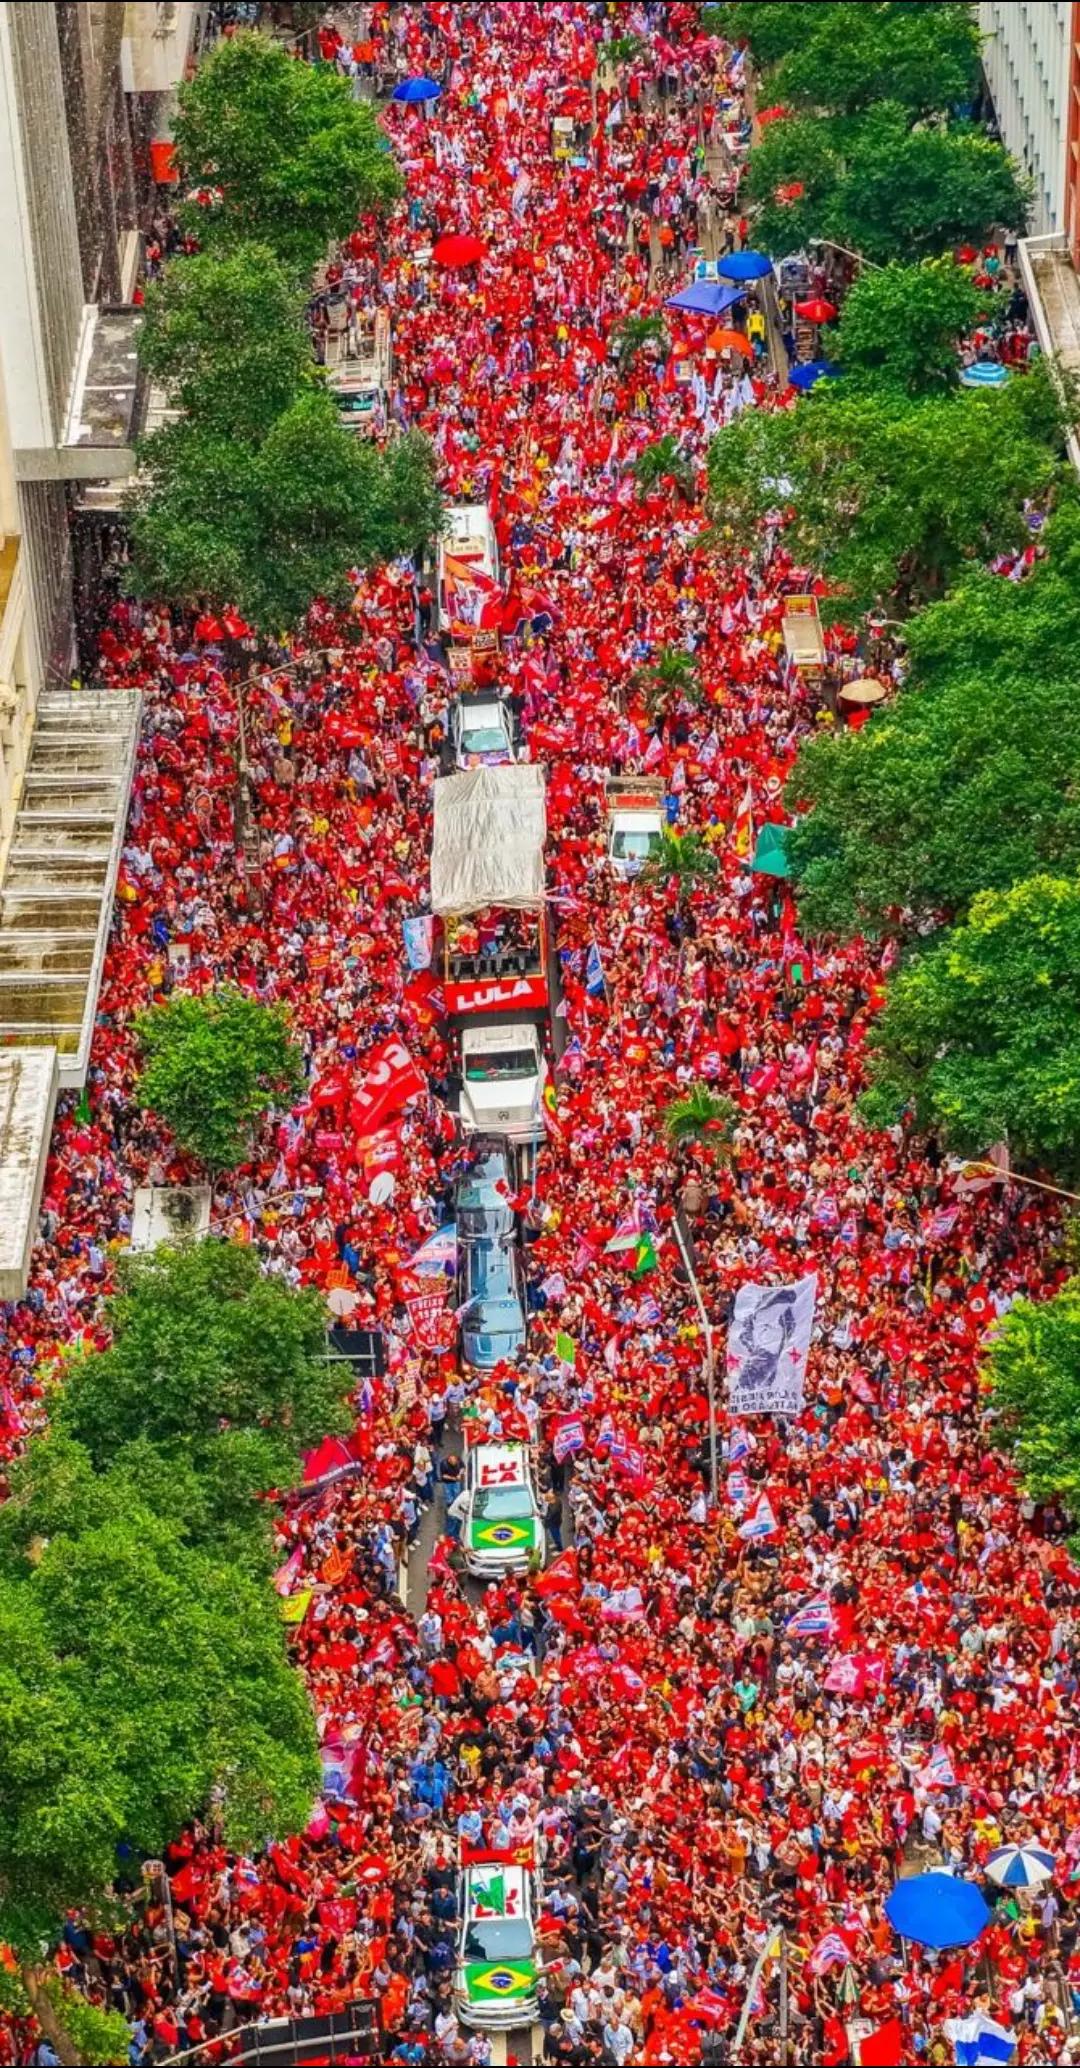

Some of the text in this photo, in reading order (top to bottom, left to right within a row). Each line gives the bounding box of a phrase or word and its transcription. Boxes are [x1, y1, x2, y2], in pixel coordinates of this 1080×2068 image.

[456, 980, 532, 1010] LULA
[482, 1462, 517, 1474] LU
[481, 1472, 517, 1485] LA
